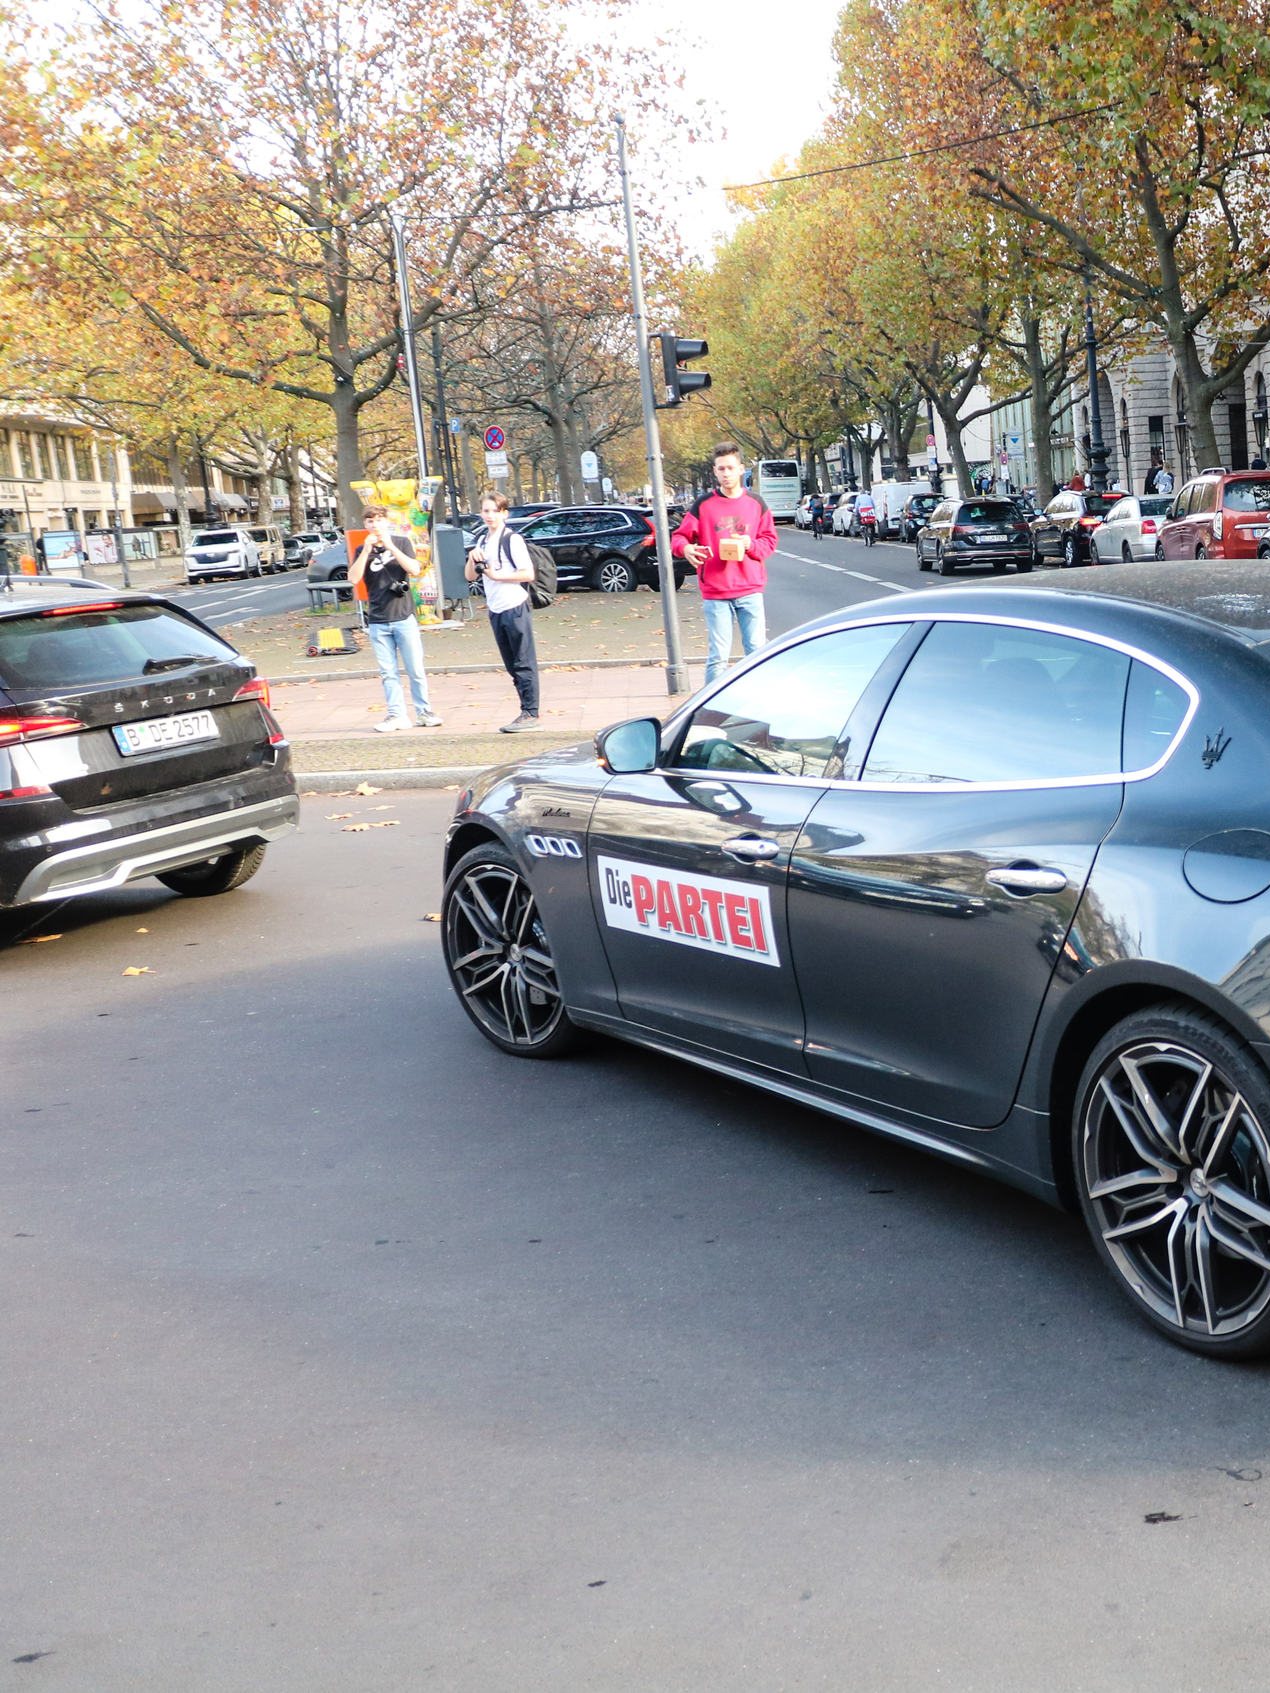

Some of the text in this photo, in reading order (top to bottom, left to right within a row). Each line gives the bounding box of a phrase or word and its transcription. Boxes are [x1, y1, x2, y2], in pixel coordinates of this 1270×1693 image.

[126, 728, 140, 747] B
[148, 722, 173, 743] DE
[173, 715, 211, 738] 2577
[605, 867, 769, 954] Die PARTEI
